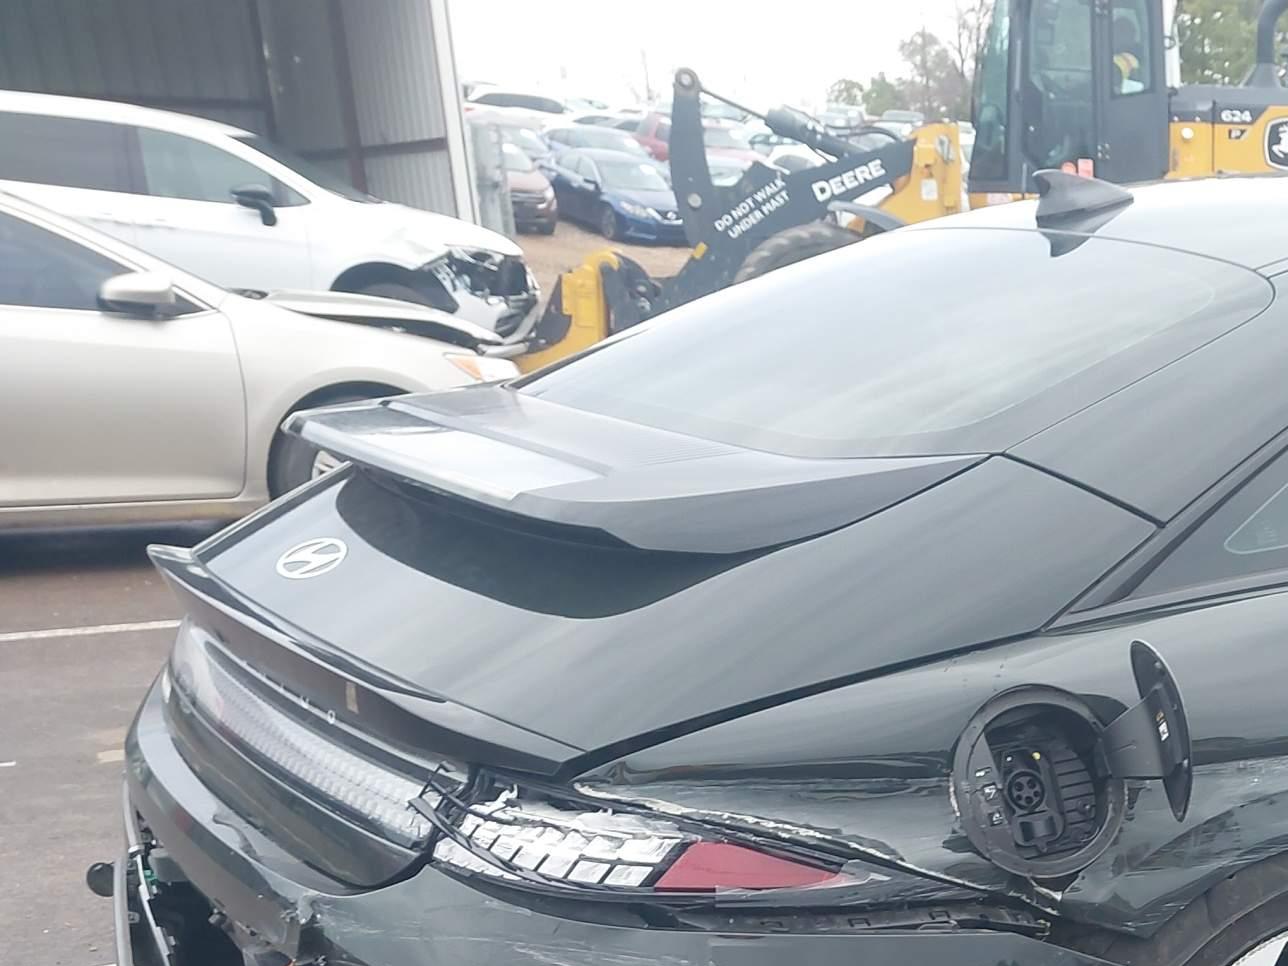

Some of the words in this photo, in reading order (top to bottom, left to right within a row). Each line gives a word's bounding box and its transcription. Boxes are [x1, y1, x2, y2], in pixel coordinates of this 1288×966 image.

[1221, 109, 1252, 122] 624
[811, 158, 886, 202] DEERE
[714, 213, 734, 232] DO
[731, 198, 755, 218] NOT
[753, 178, 788, 204] WALK
[727, 209, 765, 240] UNDER
[763, 190, 791, 216] MAST
